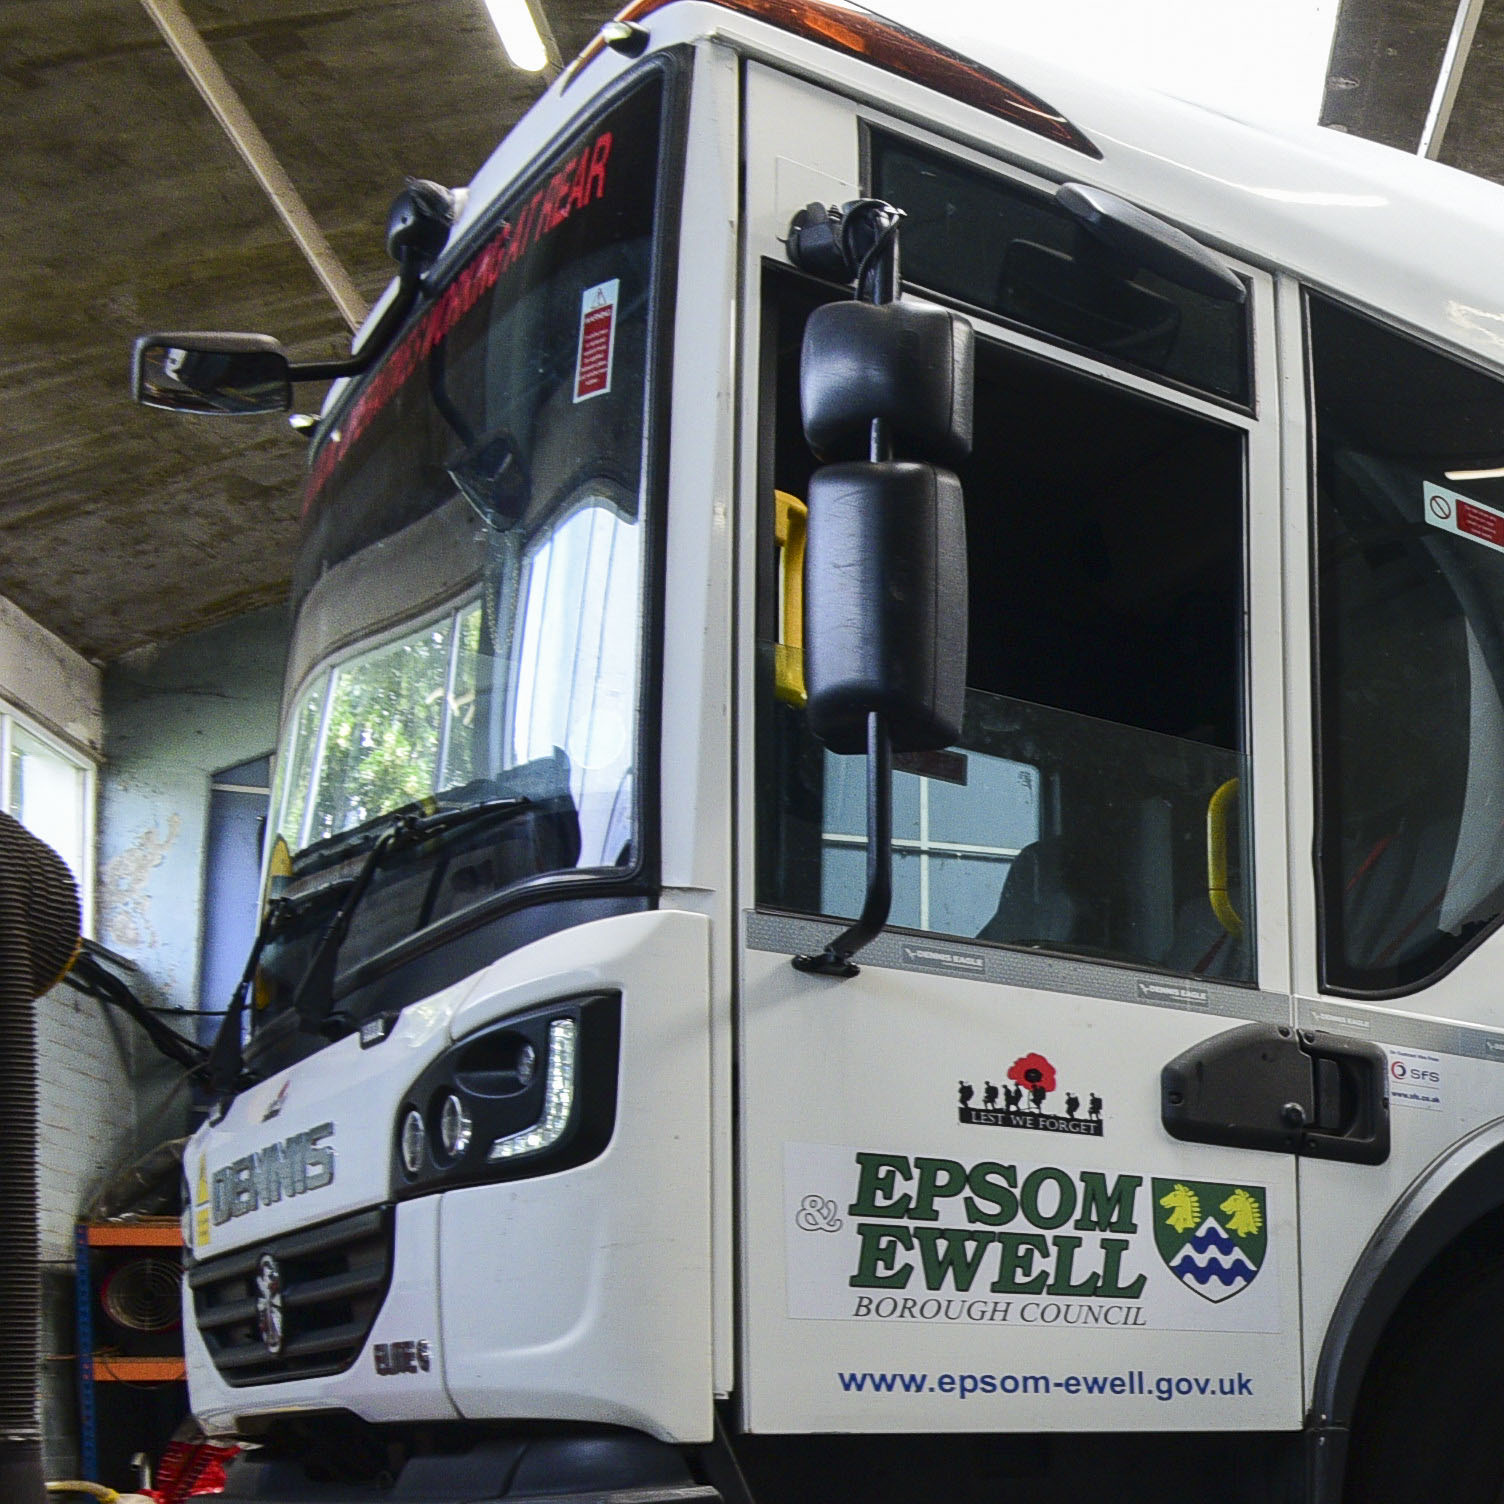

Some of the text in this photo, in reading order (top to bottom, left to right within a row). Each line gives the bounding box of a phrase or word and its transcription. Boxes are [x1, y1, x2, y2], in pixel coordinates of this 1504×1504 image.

[916, 949, 953, 964] DENNIS
[953, 954, 984, 967] EAGLE
[1181, 989, 1208, 1000] EAGLE
[970, 1111, 1097, 1134] LEST WE FORGET
[212, 1121, 336, 1227] DENNIS
[848, 1152, 1143, 1234] EPSOM
[795, 1194, 1148, 1299] & EWELL
[852, 1295, 1148, 1327] BOROUGH COUNCIL
[838, 1371, 1254, 1401] www.epsom-ewell.gov.uk
